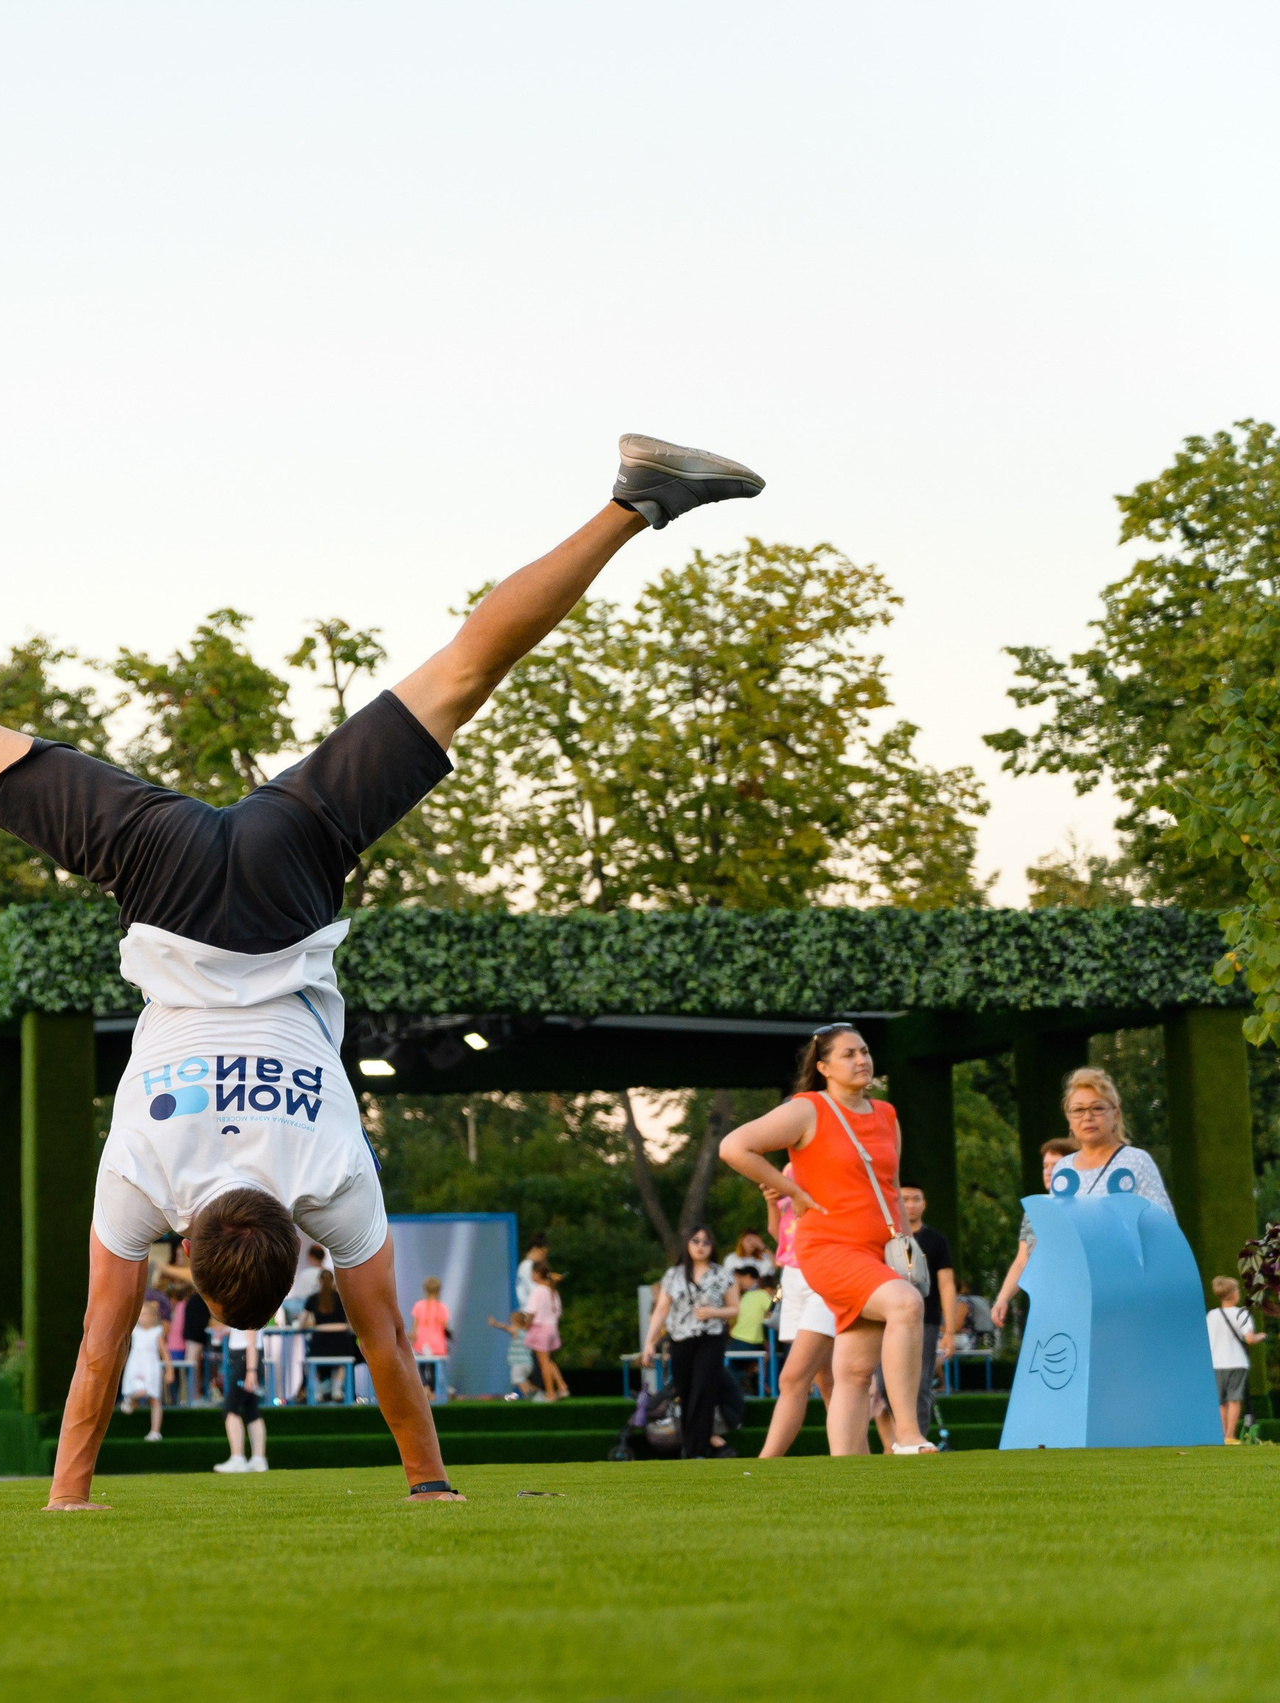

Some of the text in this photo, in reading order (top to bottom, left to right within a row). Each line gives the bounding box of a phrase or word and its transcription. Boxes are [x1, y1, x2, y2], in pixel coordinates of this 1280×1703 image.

[216, 1115, 316, 1132] ПРОГРАММА МЭРА МОСКВЫ
